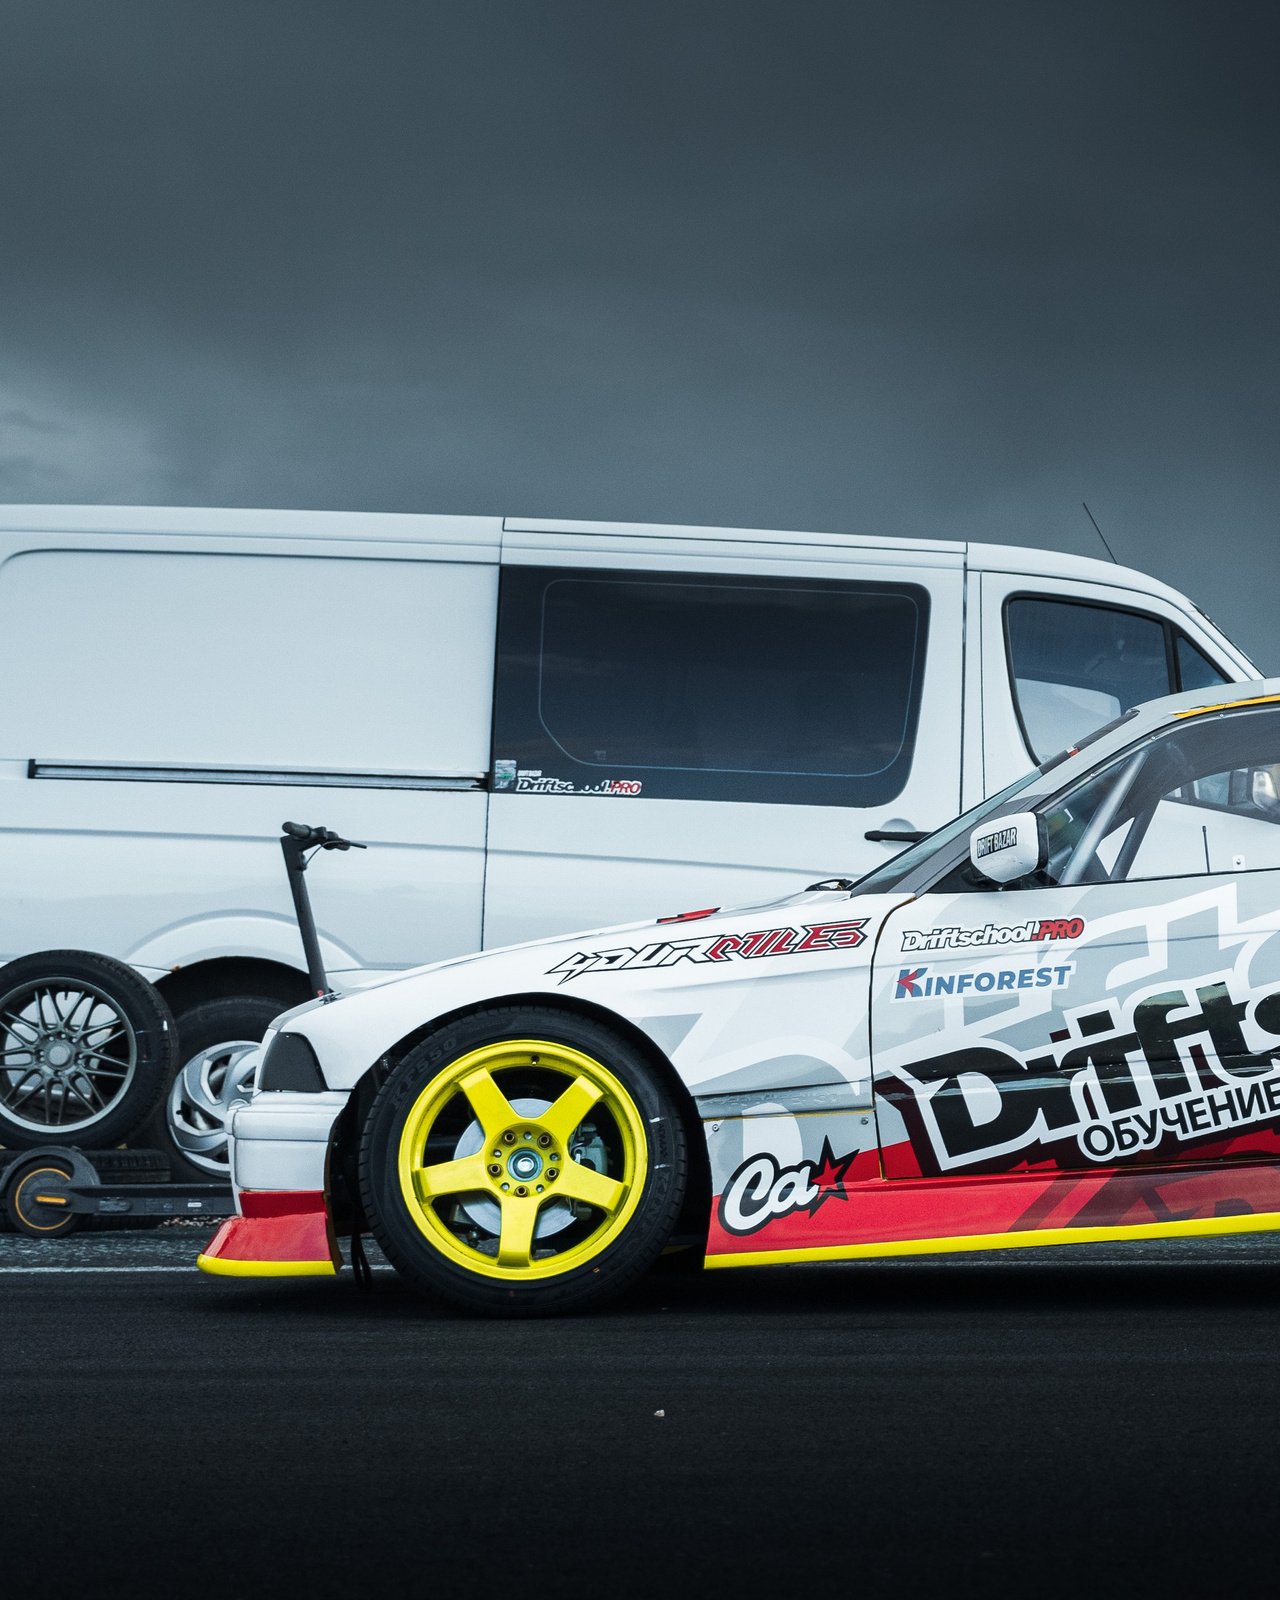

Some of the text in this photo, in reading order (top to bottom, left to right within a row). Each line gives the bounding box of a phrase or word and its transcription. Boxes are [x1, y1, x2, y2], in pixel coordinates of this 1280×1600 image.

[993, 827, 1017, 850] BAZAR
[901, 918, 1084, 952] Driftschool.PRO
[895, 966, 1071, 999] KINFOREST
